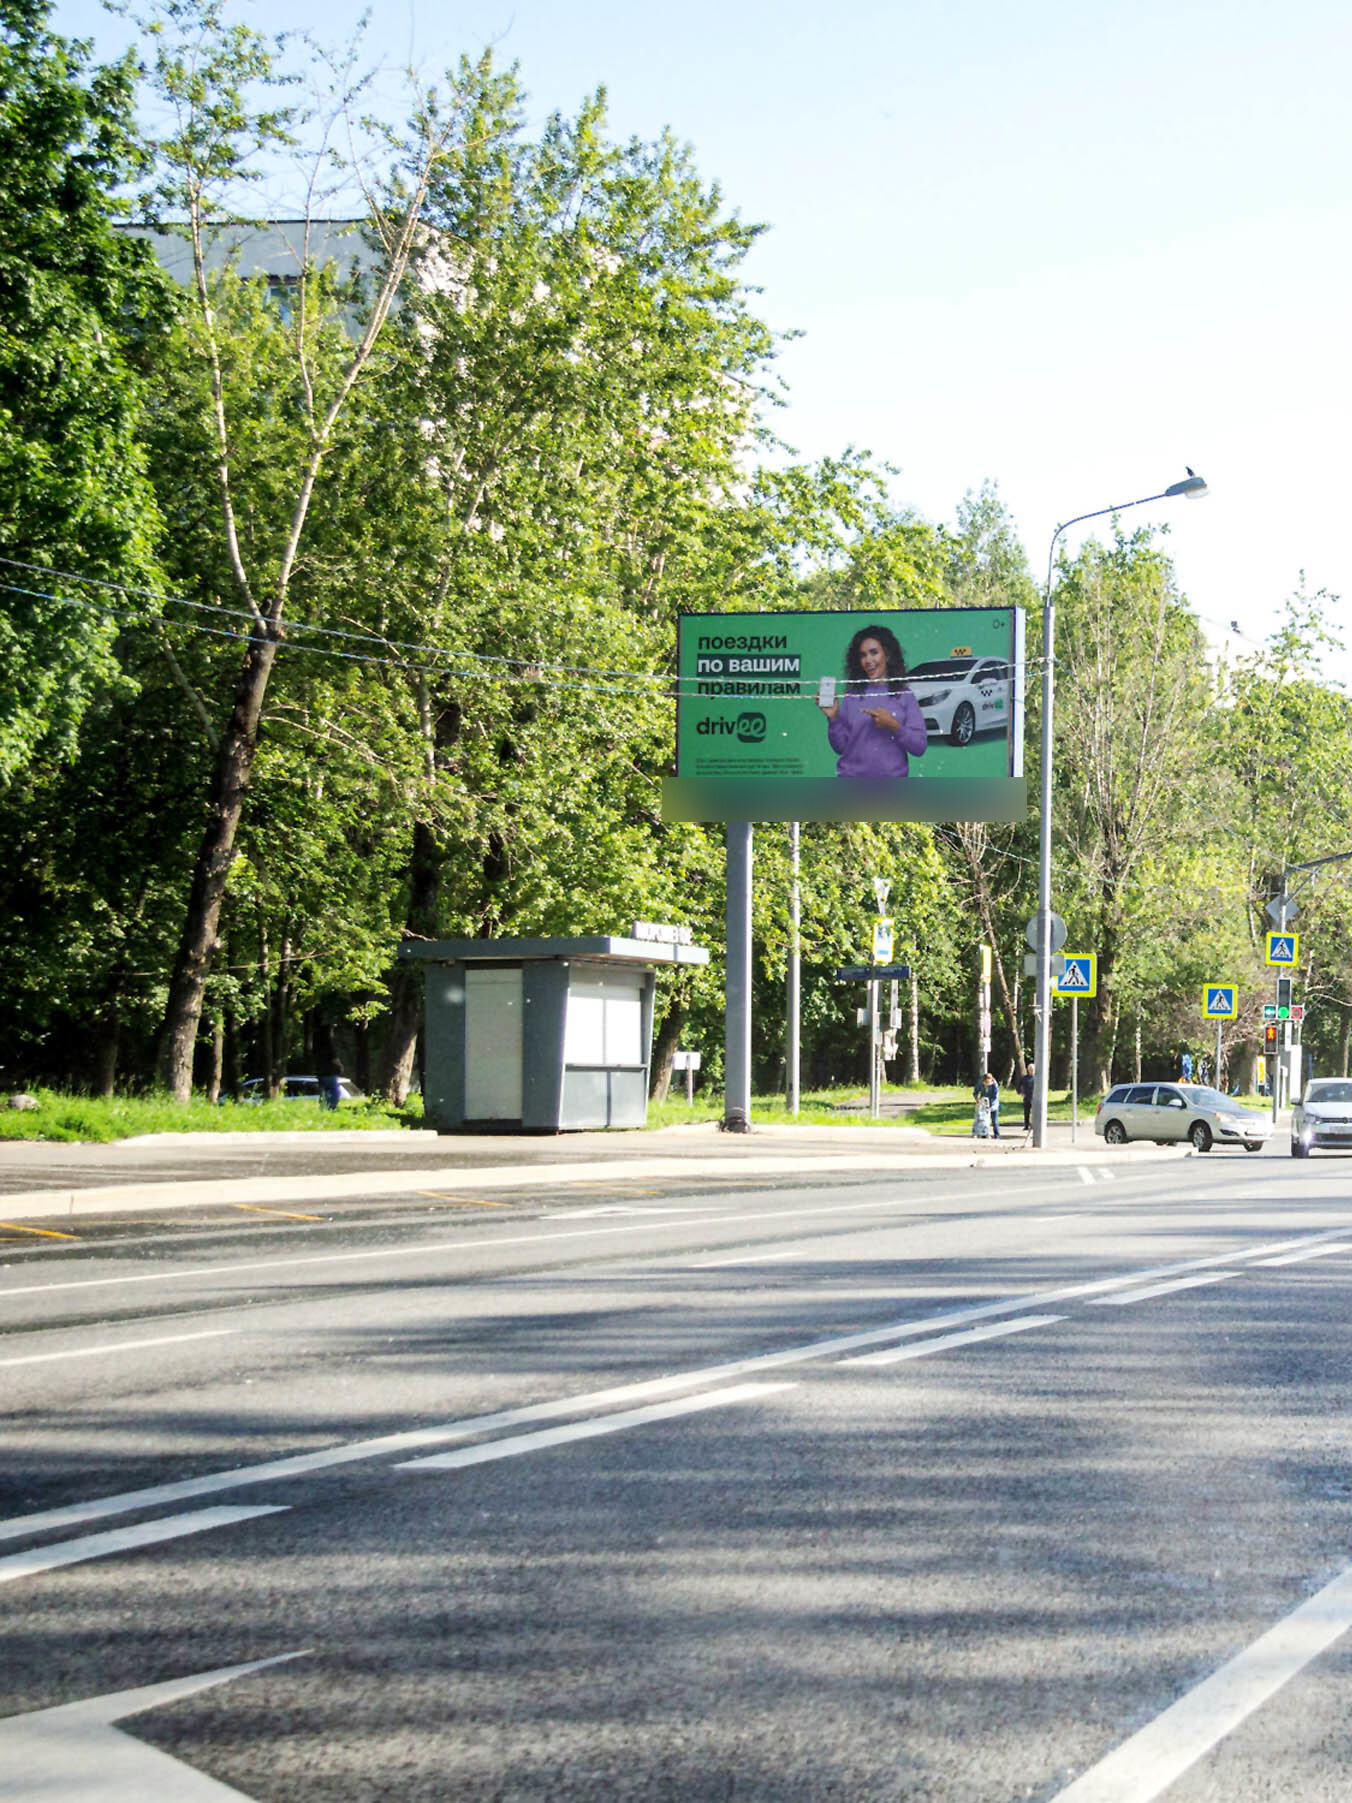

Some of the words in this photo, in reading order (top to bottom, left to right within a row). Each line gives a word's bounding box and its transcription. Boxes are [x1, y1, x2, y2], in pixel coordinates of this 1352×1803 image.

[698, 636, 787, 652] поездки
[698, 659, 723, 672] по
[729, 658, 800, 672] вашим
[697, 681, 801, 700] правилам
[696, 714, 767, 739] drivee
